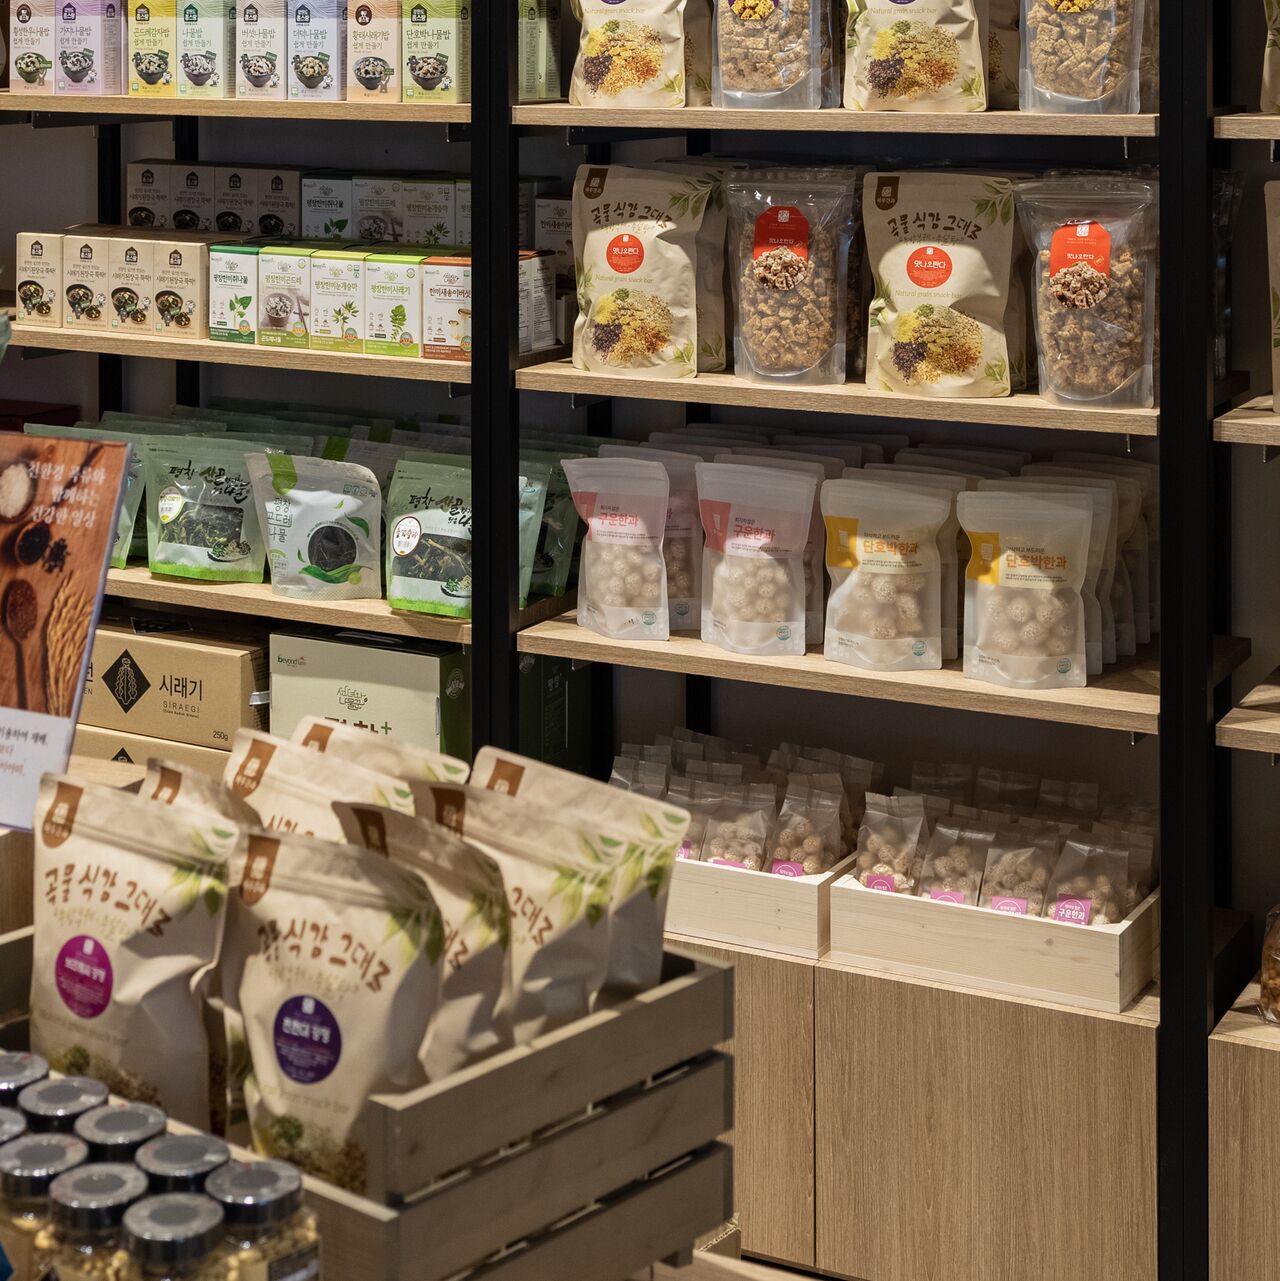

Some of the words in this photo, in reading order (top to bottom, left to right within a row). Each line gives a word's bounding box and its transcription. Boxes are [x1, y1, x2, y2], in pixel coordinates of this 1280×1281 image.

[59, 27, 92, 38] 가지나물밥
[133, 27, 170, 38] 곤드레감자밥
[182, 29, 202, 39] 나물밥
[241, 28, 276, 39] 버섯나물밥
[292, 28, 327, 39] 더덕나물밥
[406, 29, 452, 40] 단호박나물밥
[146, 38, 163, 46] 만들기
[422, 40, 440, 49] 만들기
[590, 202, 610, 225] 곡물
[613, 202, 637, 218] 식감
[638, 204, 673, 228] 그대로
[887, 213, 908, 236] 곡물
[913, 211, 941, 229] 식감
[943, 215, 982, 240] 그대로
[599, 512, 639, 528] 구운한과
[733, 524, 776, 543] 구운한과
[863, 540, 918, 554] 단호박한과
[1006, 554, 1067, 570] 단호박한과
[159, 673, 202, 702] 시래기
[163, 700, 200, 713] SIRAEGI
[213, 730, 229, 741] 250g
